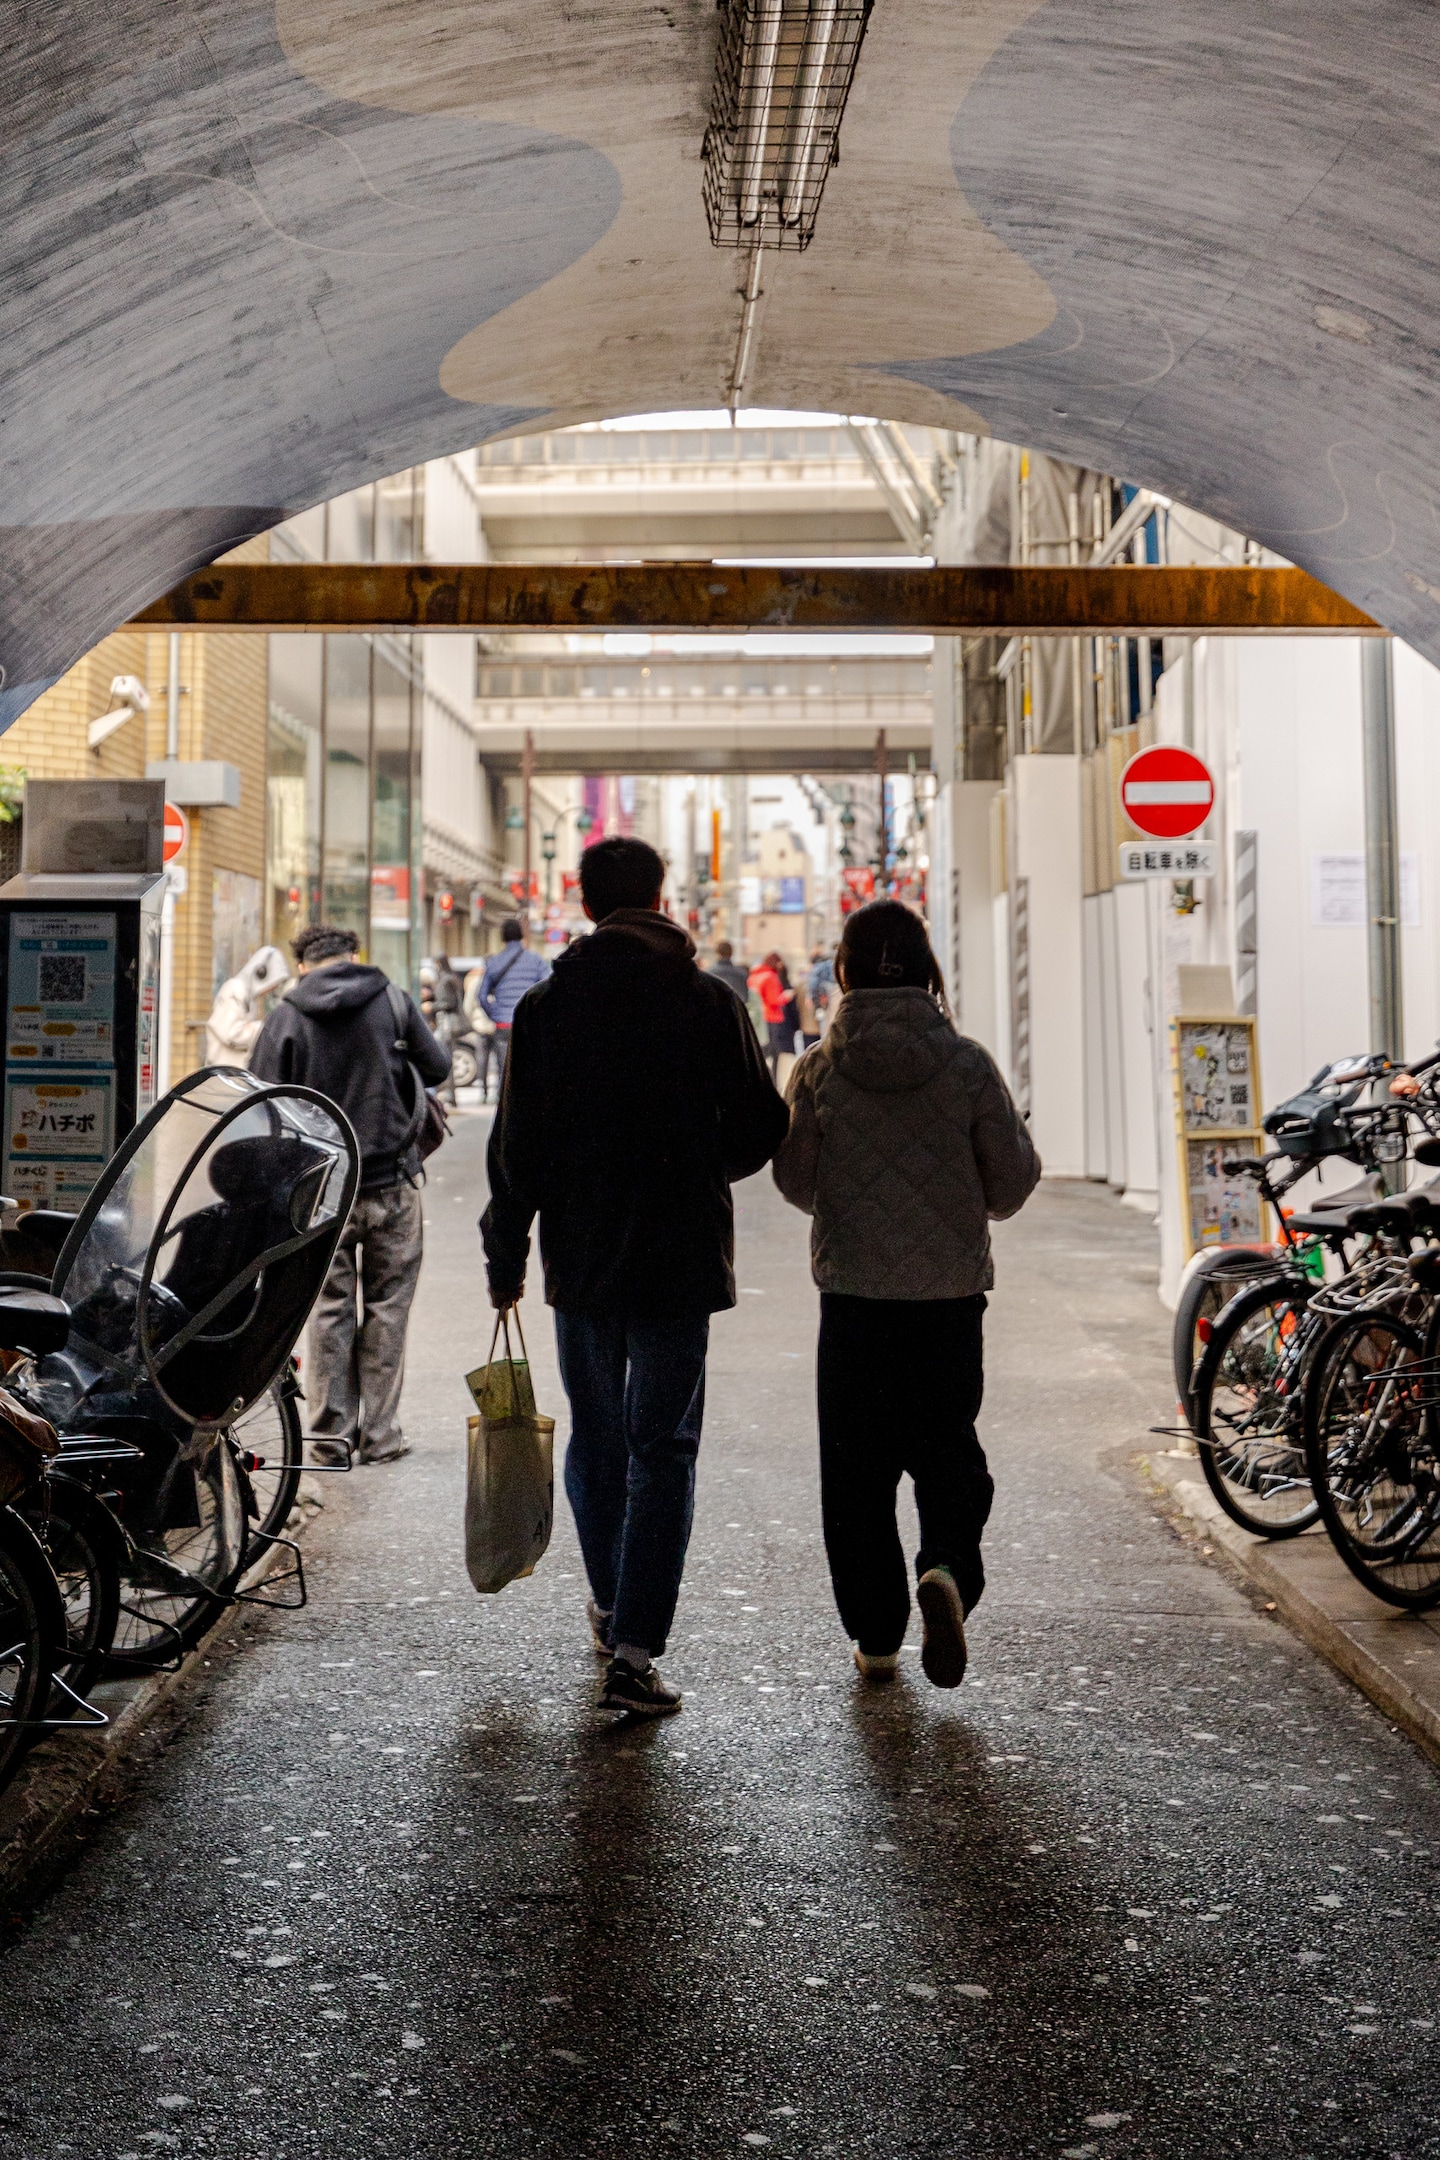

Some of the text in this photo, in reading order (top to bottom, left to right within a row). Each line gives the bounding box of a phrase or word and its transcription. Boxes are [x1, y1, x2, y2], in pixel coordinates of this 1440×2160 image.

[1128, 851, 1210, 870] 自転車を除く
[38, 1113, 96, 1133] ハチポ
[13, 1165, 48, 1177] ハチくじ
